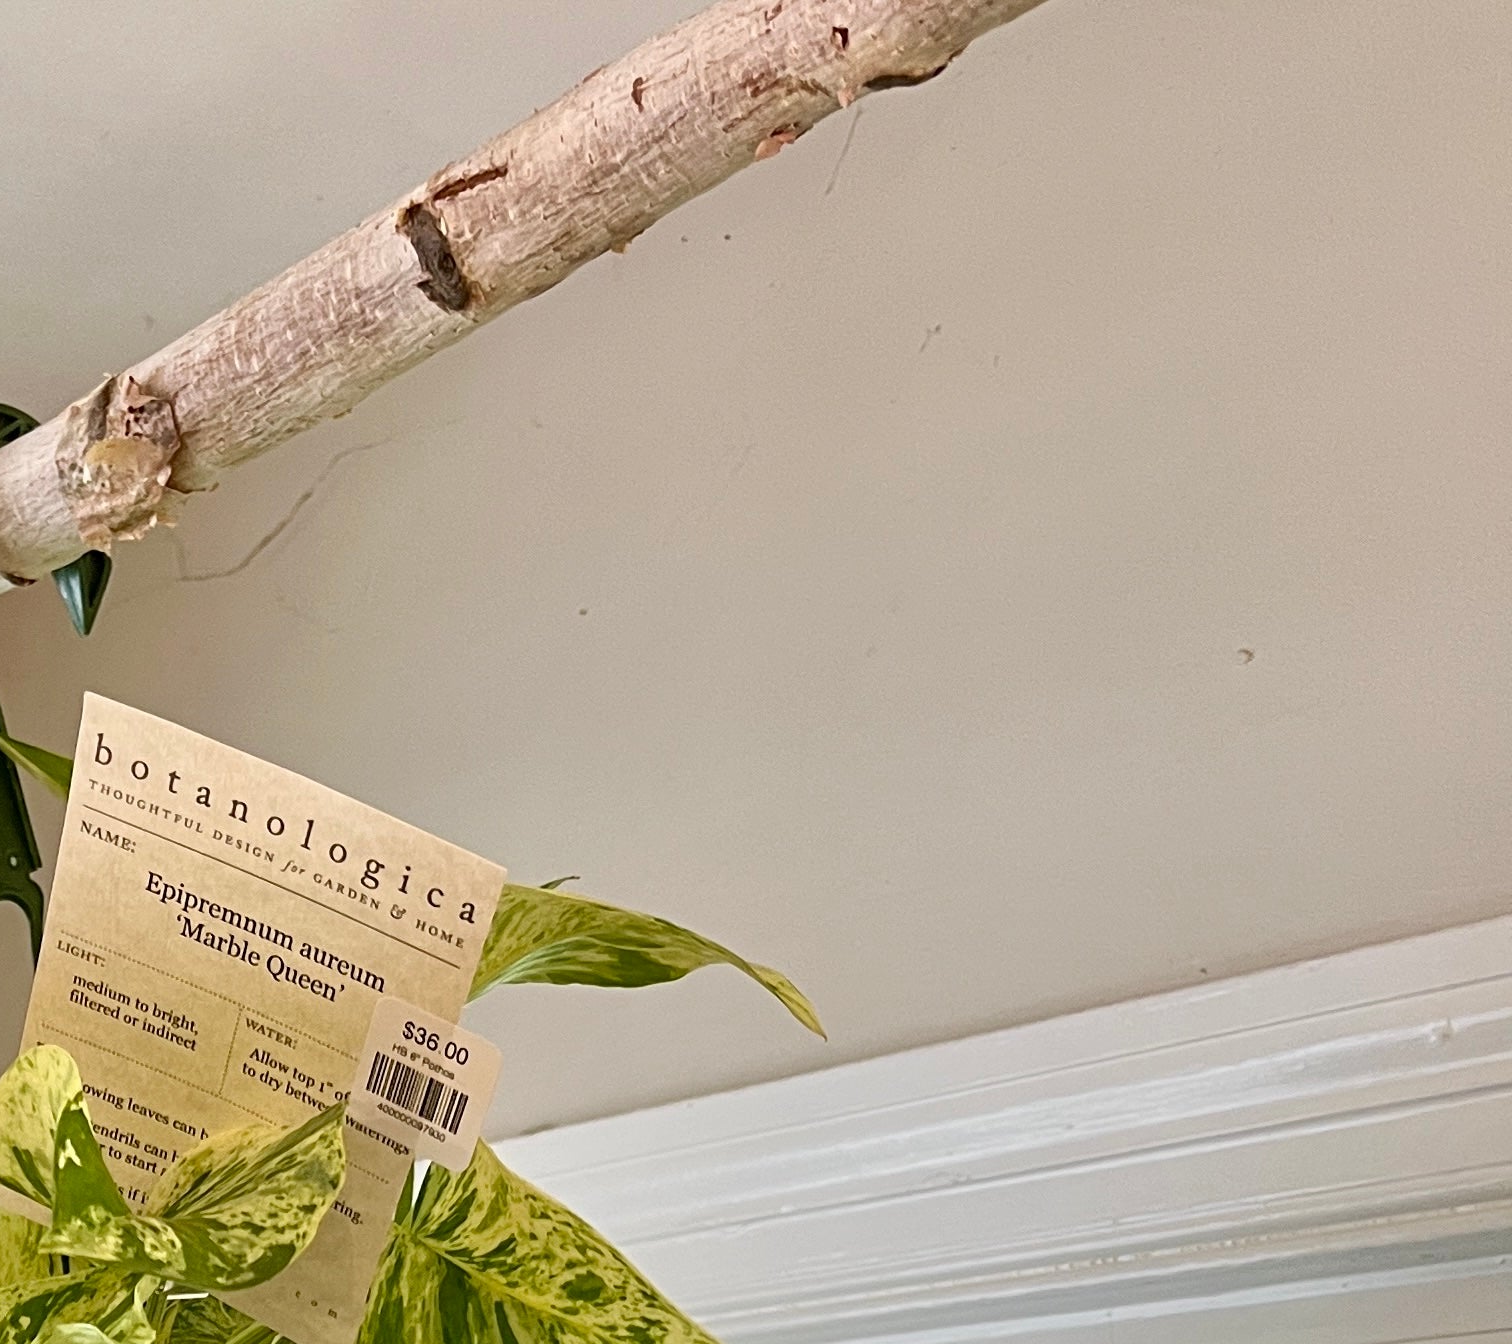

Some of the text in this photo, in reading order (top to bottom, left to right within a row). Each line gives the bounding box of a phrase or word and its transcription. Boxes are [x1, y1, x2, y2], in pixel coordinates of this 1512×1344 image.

[80, 820, 137, 853] NAME:
[94, 733, 476, 924] botanologica
[88, 779, 465, 949] THOUGHTFUL DESIGN for GARDEN & HOME
[56, 940, 106, 968] LIGHT:
[145, 871, 386, 994] Epipremnum aureum
[69, 988, 197, 1051] filtered or indirect
[72, 975, 199, 1036] medium to bright,
[245, 1017, 298, 1050] WATER:
[391, 1043, 408, 1057] HB
[402, 1021, 469, 1066] $36.00
[241, 1062, 332, 1112] to dry betwe
[249, 1048, 289, 1074] Allow
[292, 1067, 316, 1089] top
[82, 1083, 124, 1110] owing
[127, 1097, 169, 1125] leaves
[172, 1120, 197, 1136] can
[91, 1123, 140, 1149] endrils
[143, 1143, 168, 1160] can
[108, 1145, 122, 1160] to
[124, 1153, 157, 1173] start
